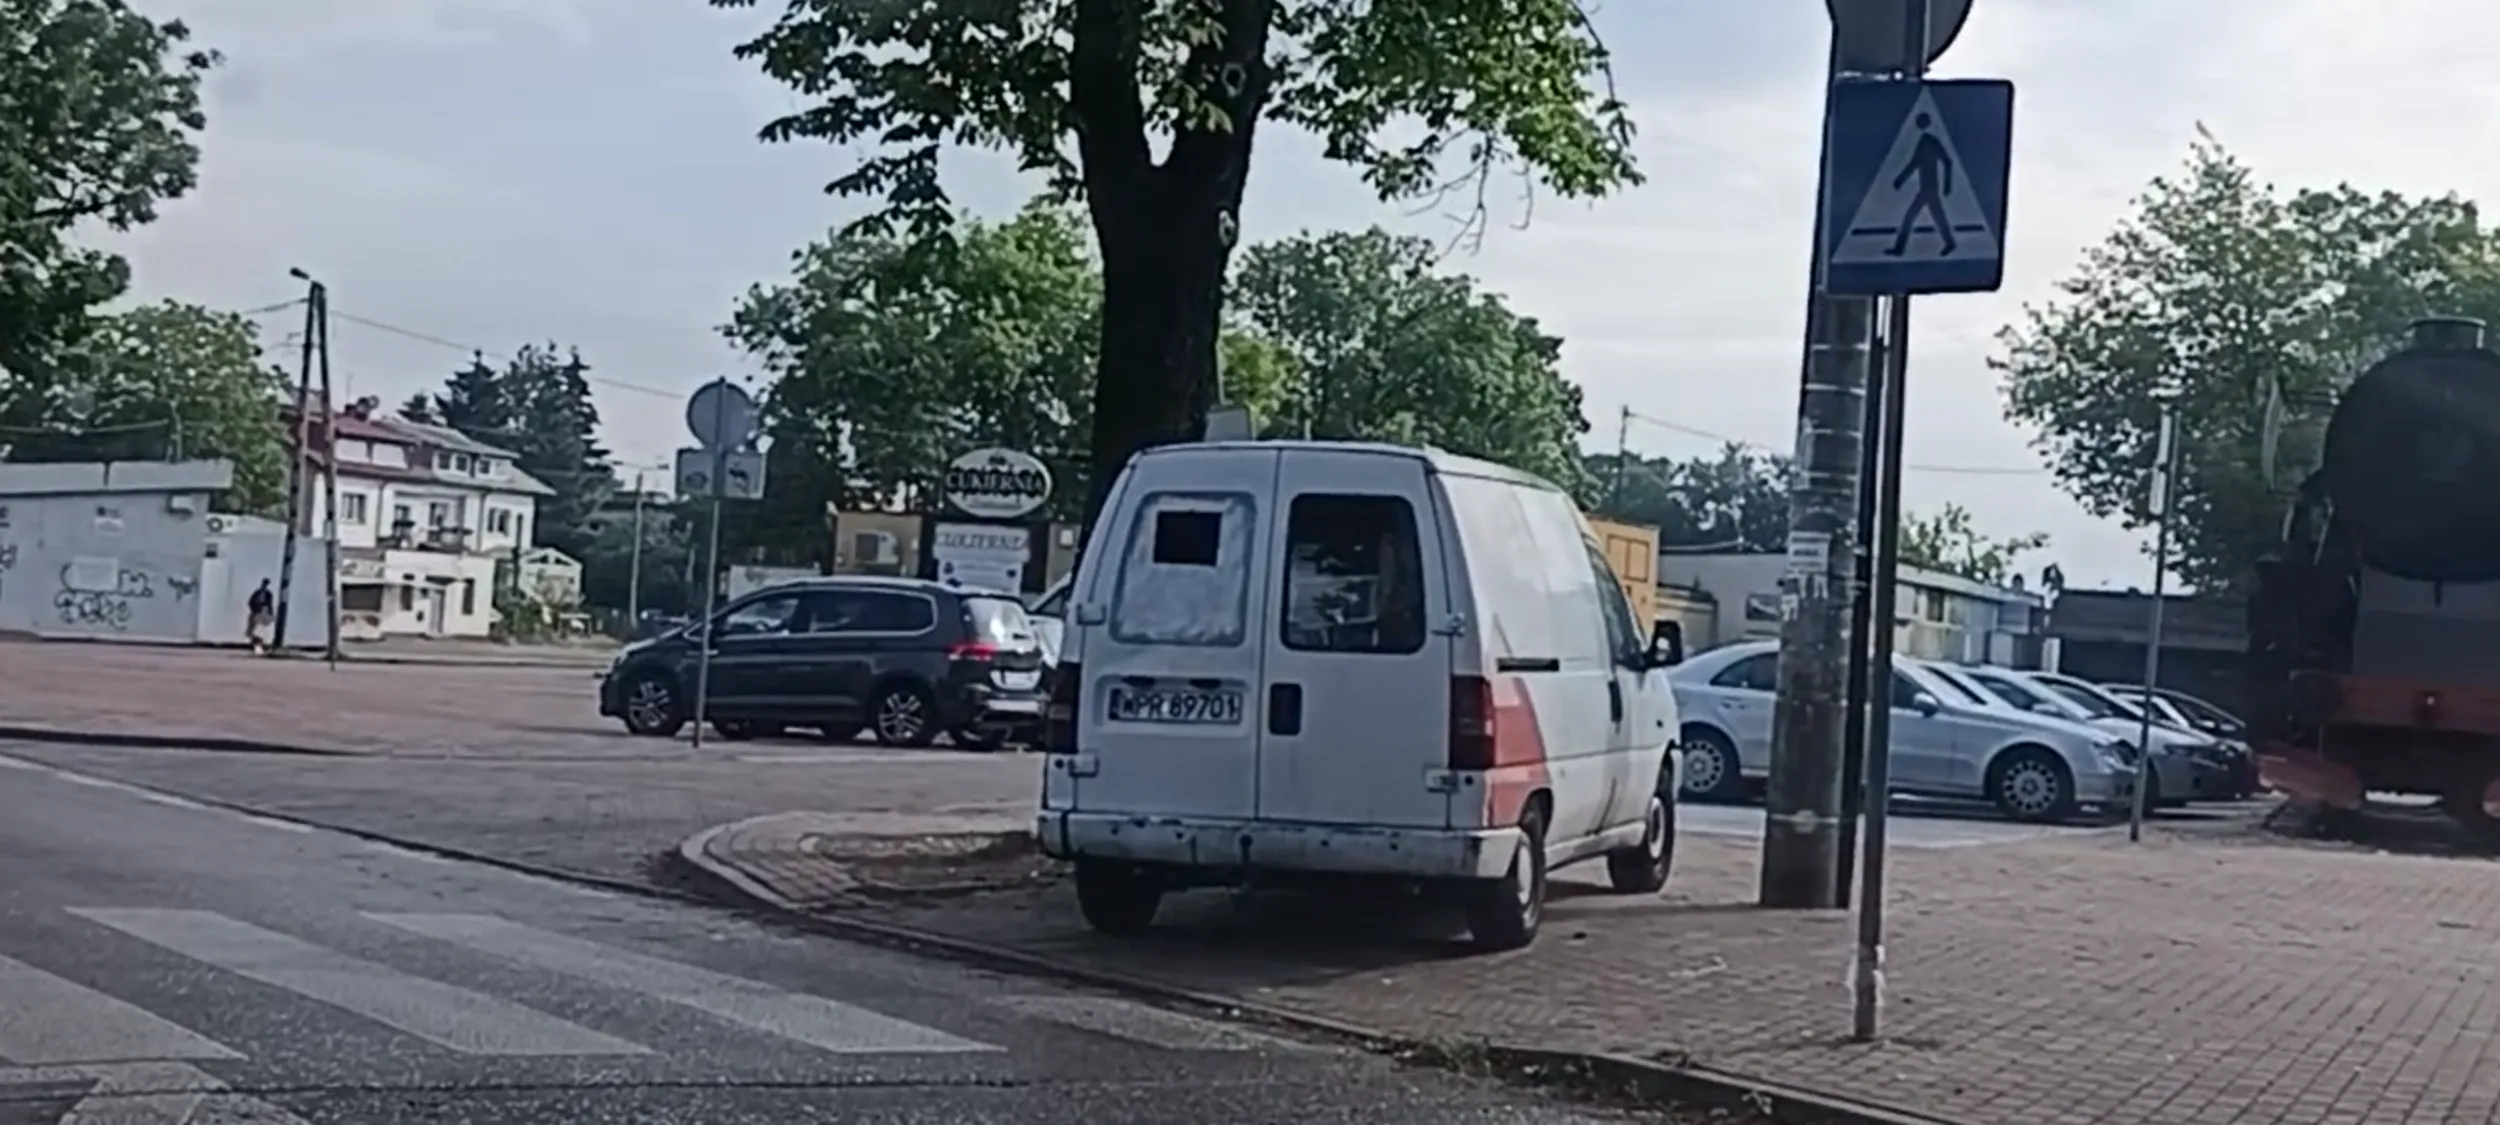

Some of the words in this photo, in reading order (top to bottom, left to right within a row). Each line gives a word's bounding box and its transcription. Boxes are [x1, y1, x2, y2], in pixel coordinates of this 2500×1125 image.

[947, 473, 1044, 492] CUKIERNIA
[1121, 692, 1164, 719] WPR
[1169, 694, 1237, 719] 89701
